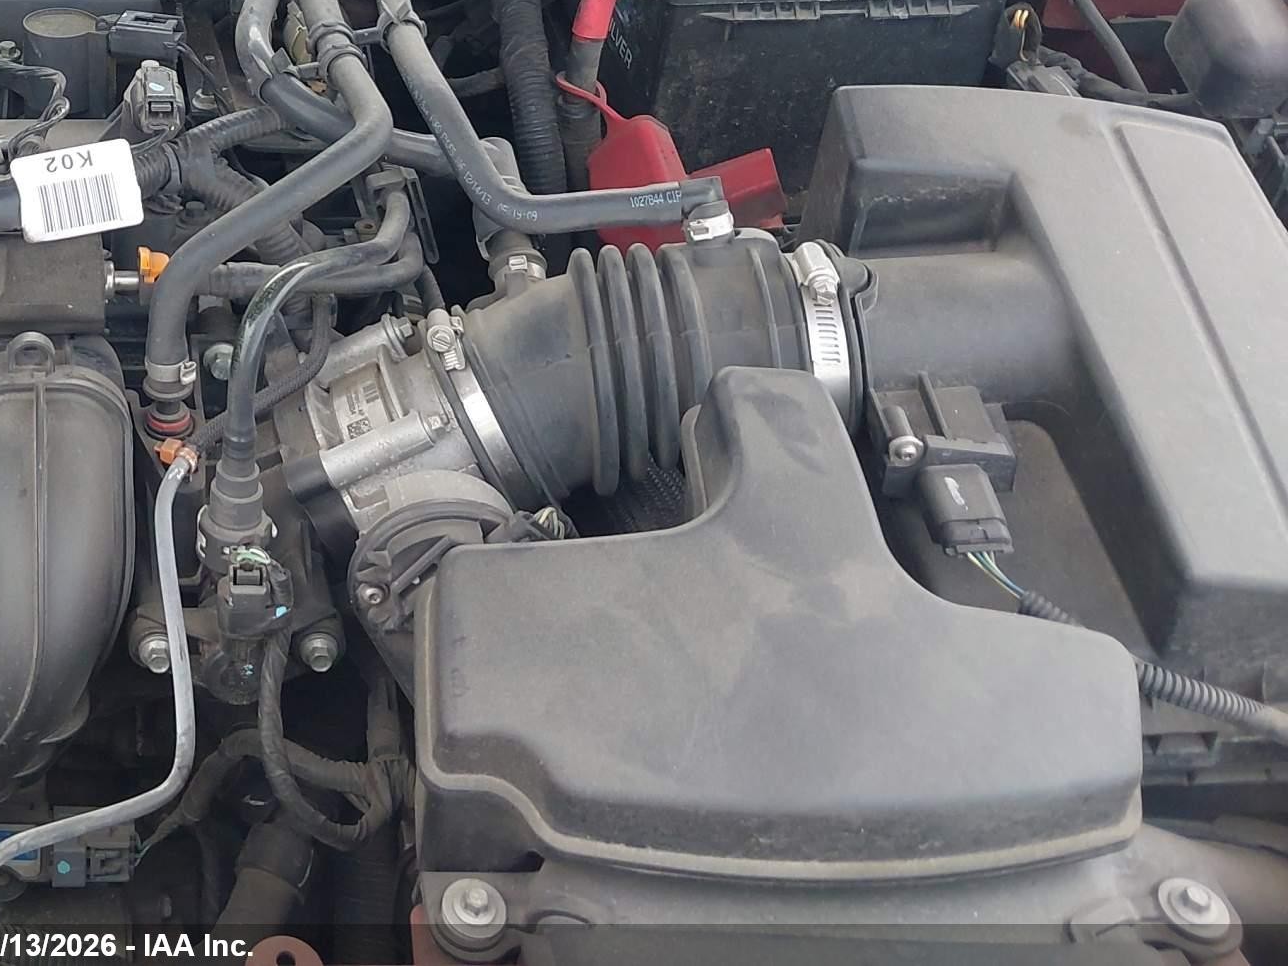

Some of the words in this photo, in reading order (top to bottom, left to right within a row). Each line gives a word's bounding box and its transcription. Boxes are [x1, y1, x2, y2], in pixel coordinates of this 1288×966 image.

[609, 17, 633, 70] ILVER
[44, 150, 94, 173] K02
[629, 192, 665, 208] 1027844
